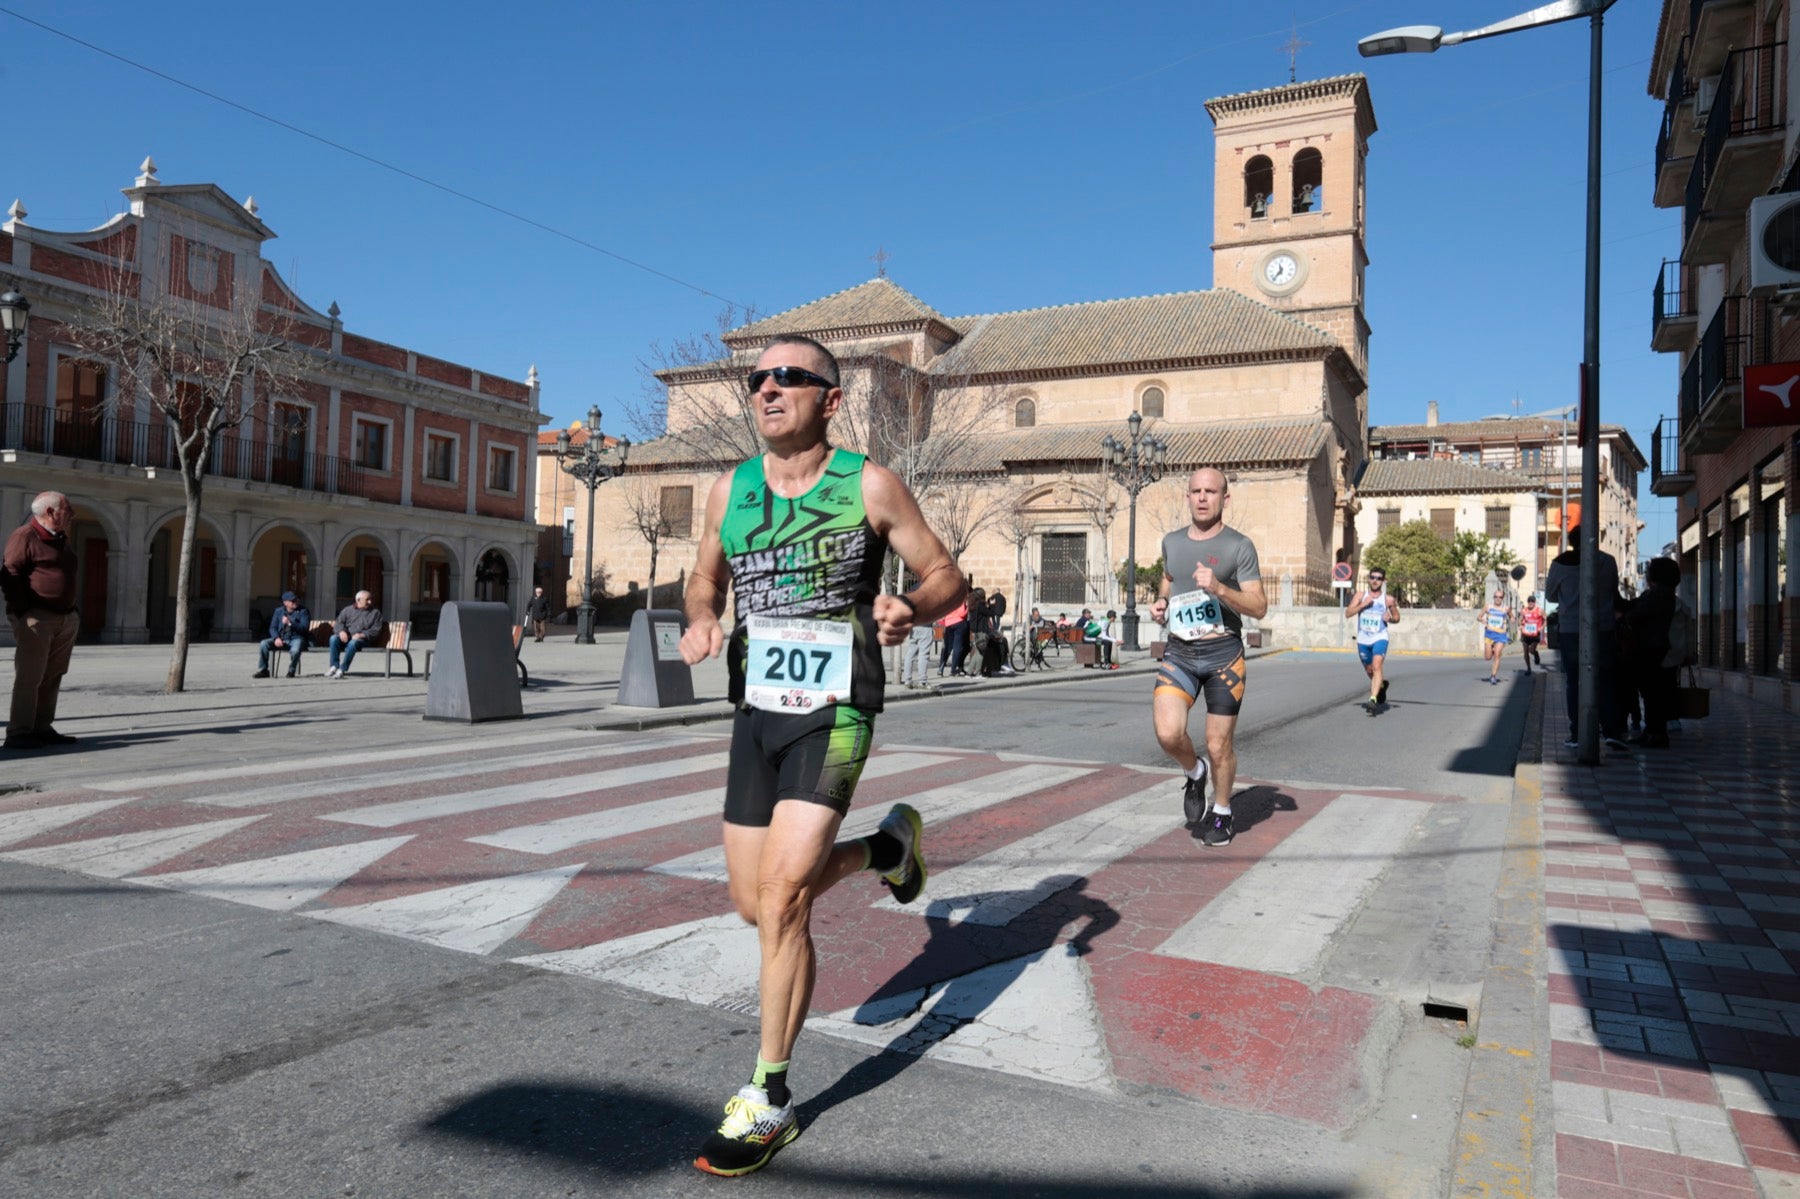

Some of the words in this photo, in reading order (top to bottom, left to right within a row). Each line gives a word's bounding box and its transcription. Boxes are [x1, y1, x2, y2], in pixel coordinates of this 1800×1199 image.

[1175, 603, 1216, 623] 1156
[824, 622, 847, 635] FONDO
[764, 646, 832, 684] 207
